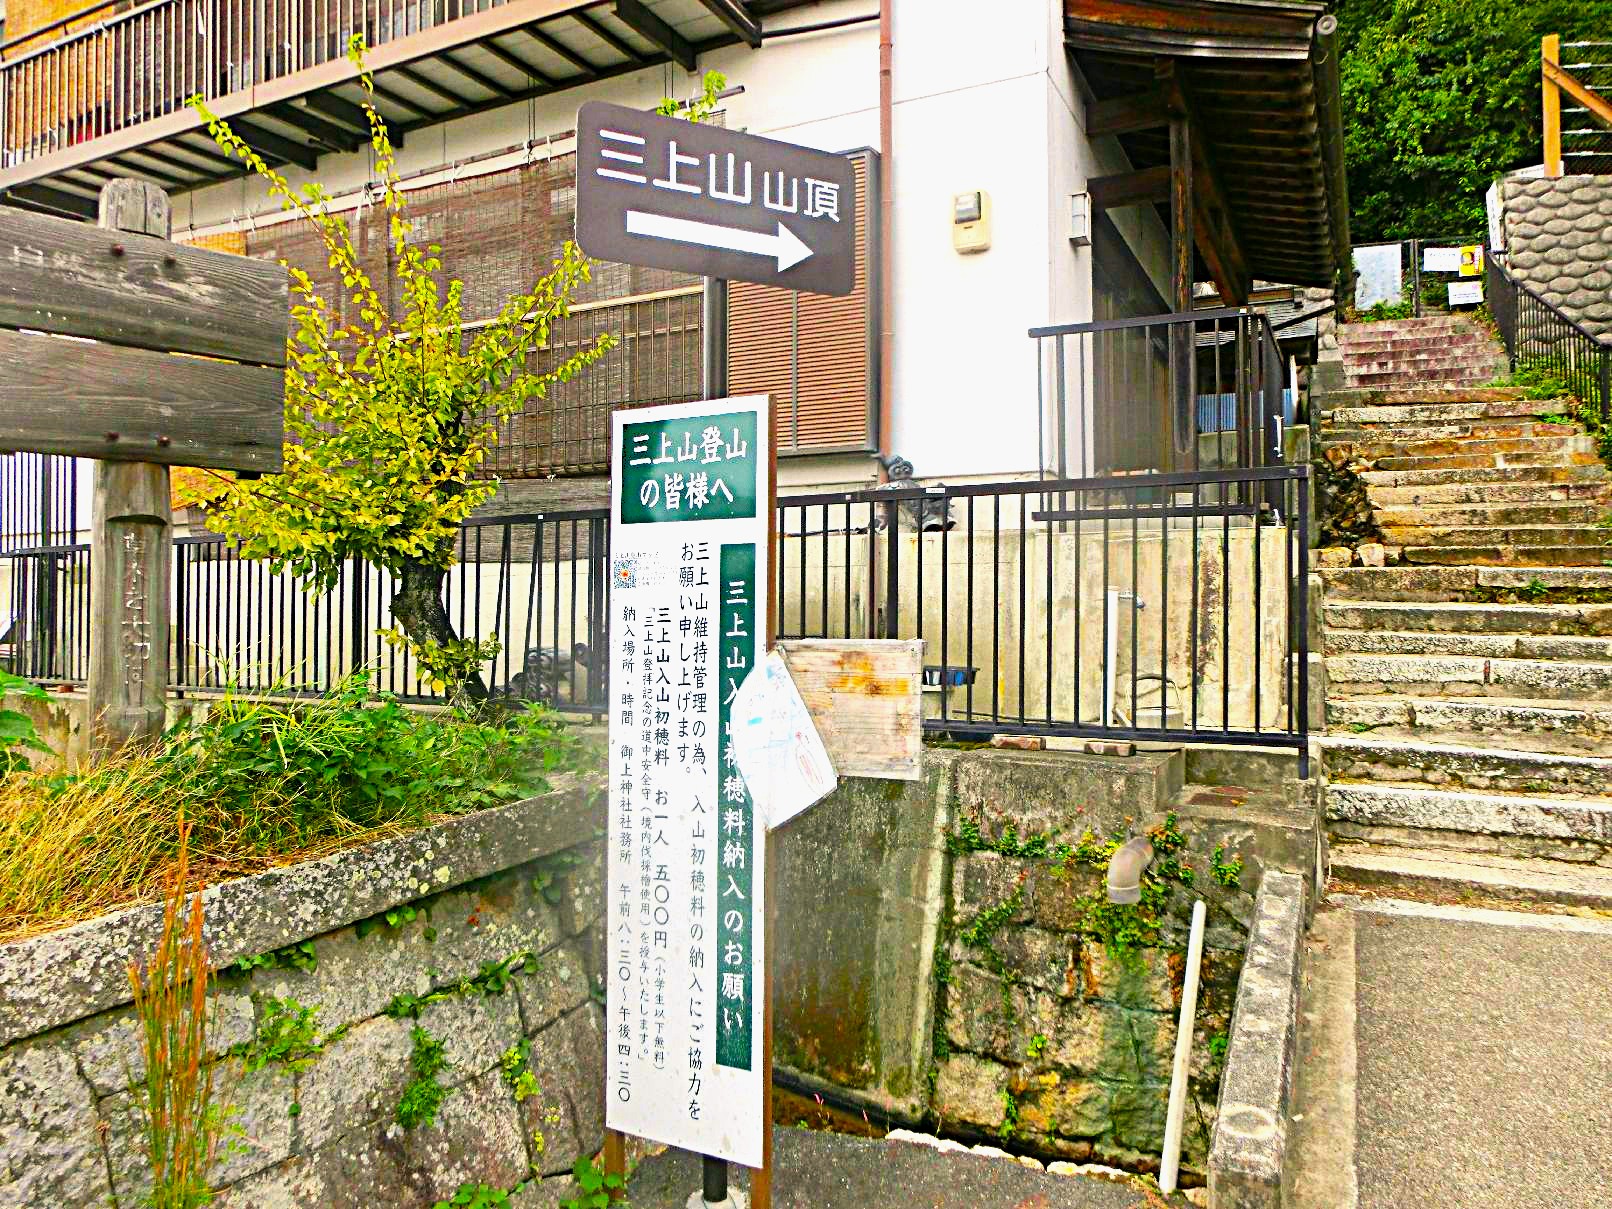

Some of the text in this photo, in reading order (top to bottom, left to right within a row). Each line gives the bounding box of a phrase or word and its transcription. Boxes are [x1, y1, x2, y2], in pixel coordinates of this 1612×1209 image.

[596, 129, 840, 223] 三上山山頂
[629, 425, 748, 466] 三上山登山
[640, 471, 734, 510] の皆様へ
[621, 605, 636, 727] 納入場所・時間
[653, 607, 672, 767] 三上山入山初穂料
[676, 542, 694, 774] お願い申し上げます。
[619, 744, 634, 865] 御上神社社務所
[653, 788, 670, 846] お一人
[687, 542, 710, 1121] 三上山維持管理の為、入山初穂料の納入にご協力を
